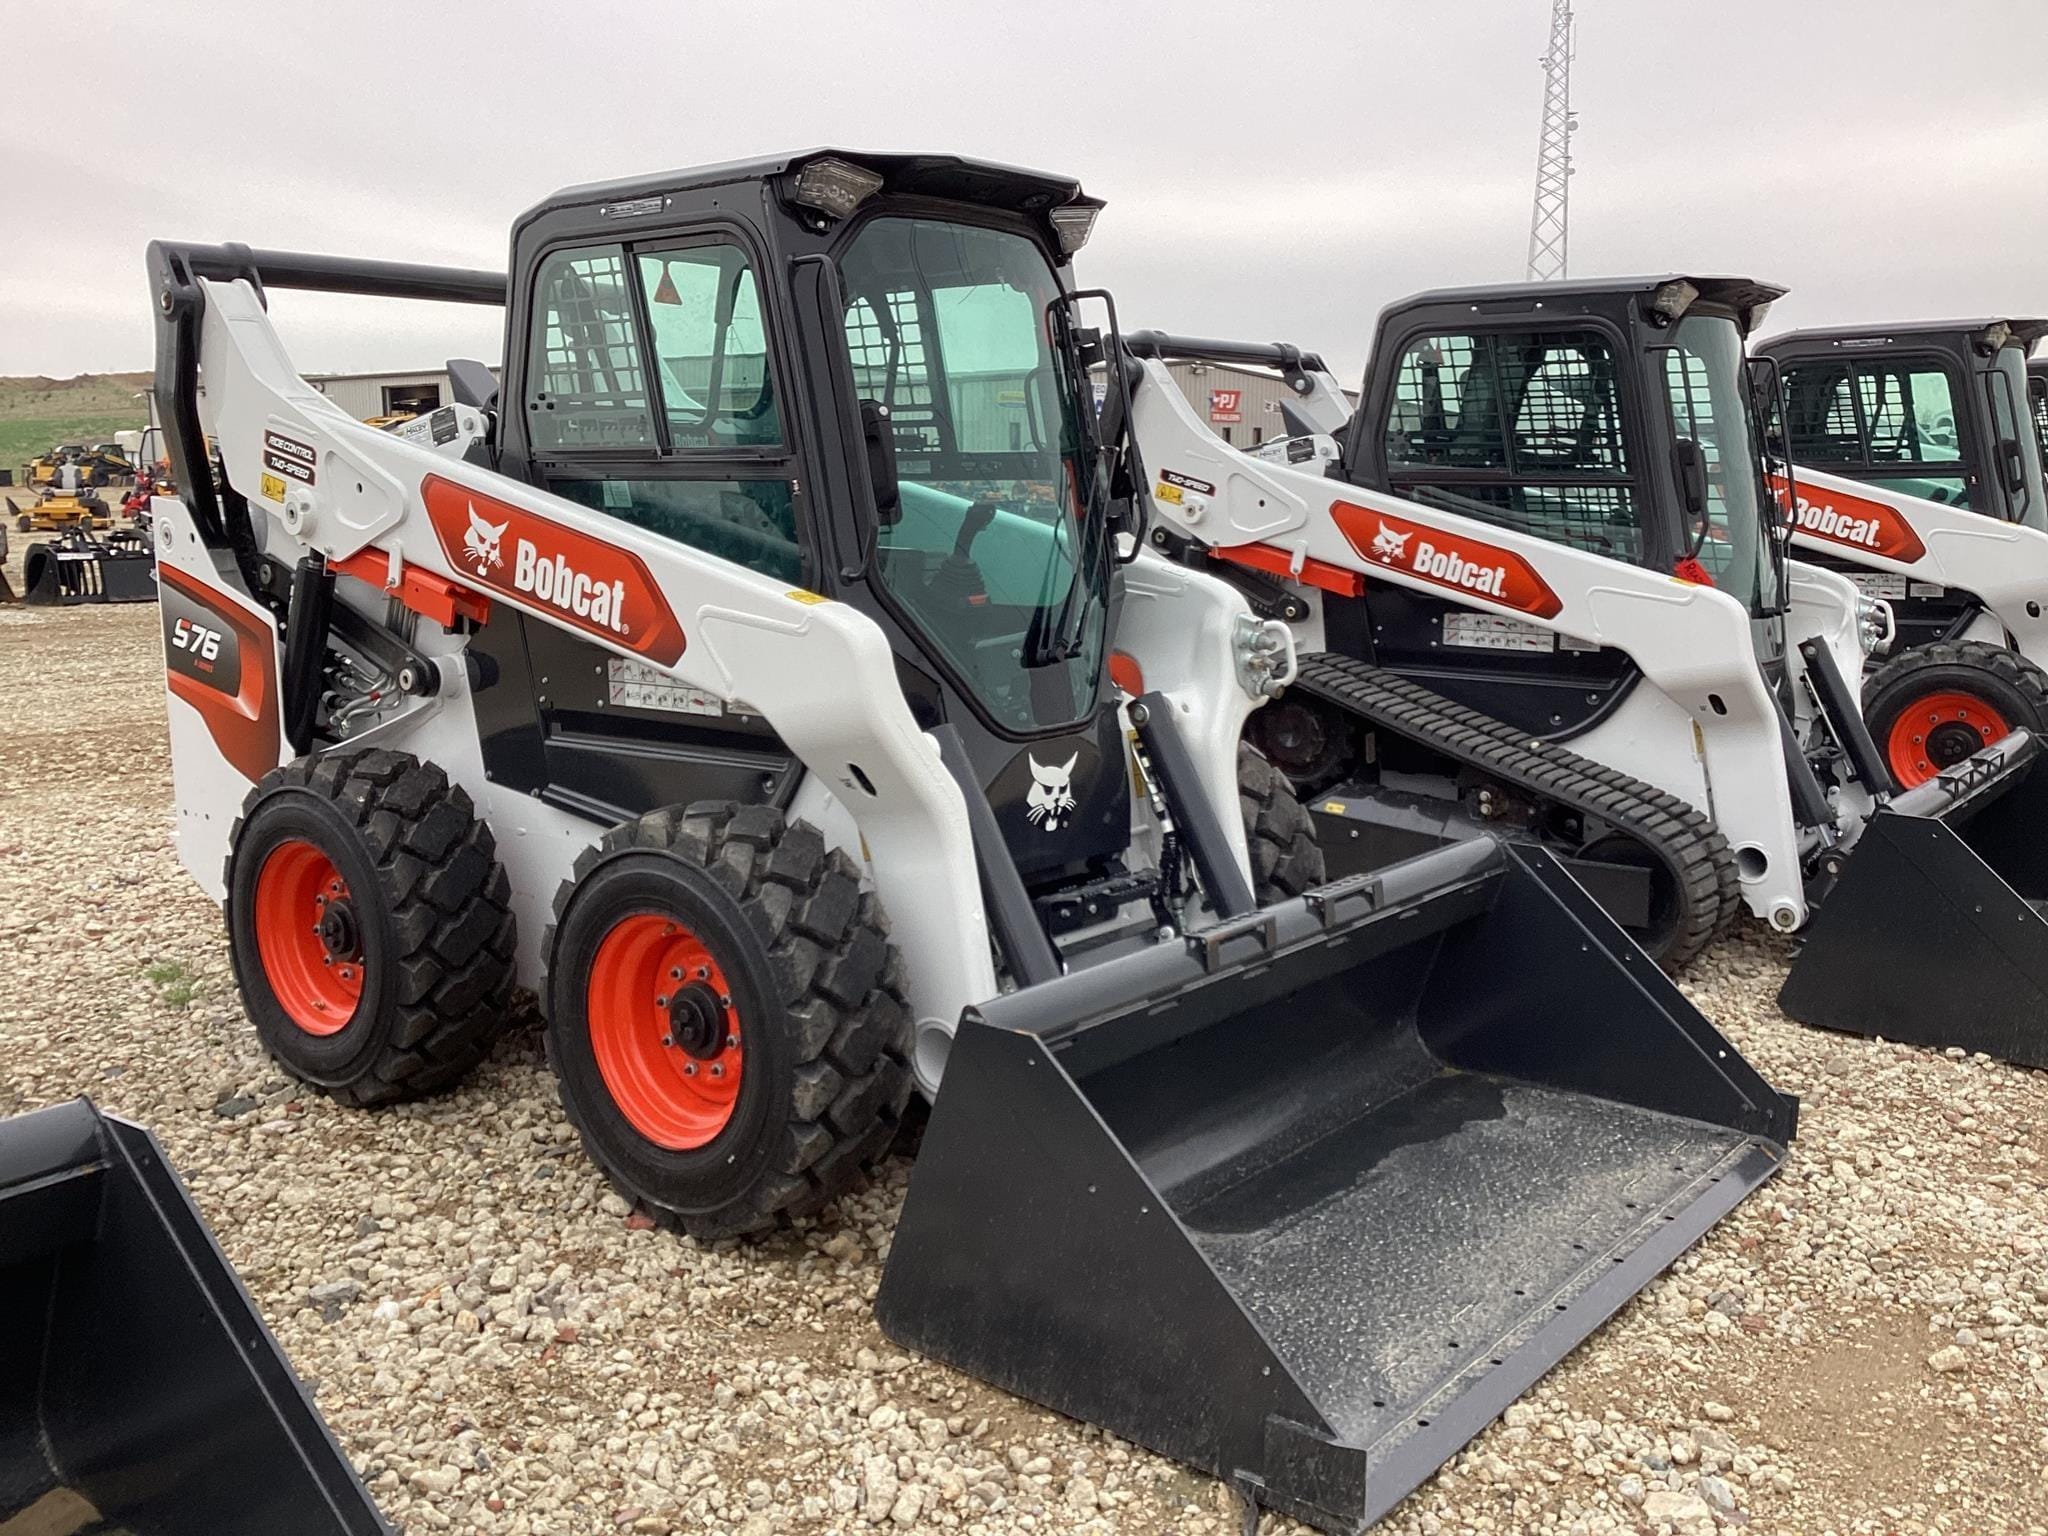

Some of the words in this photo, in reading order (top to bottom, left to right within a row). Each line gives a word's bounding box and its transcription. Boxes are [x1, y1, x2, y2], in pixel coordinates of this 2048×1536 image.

[1219, 393, 1236, 409] PJ
[283, 441, 314, 460] CONTROL
[271, 457, 310, 479] TWO-SPEED
[1168, 473, 1210, 492] TWO-SPEED
[1787, 497, 1880, 547] Bobcat
[514, 538, 625, 632] Bobcat
[1413, 541, 1506, 597] Bobcat
[172, 618, 221, 661] S76
